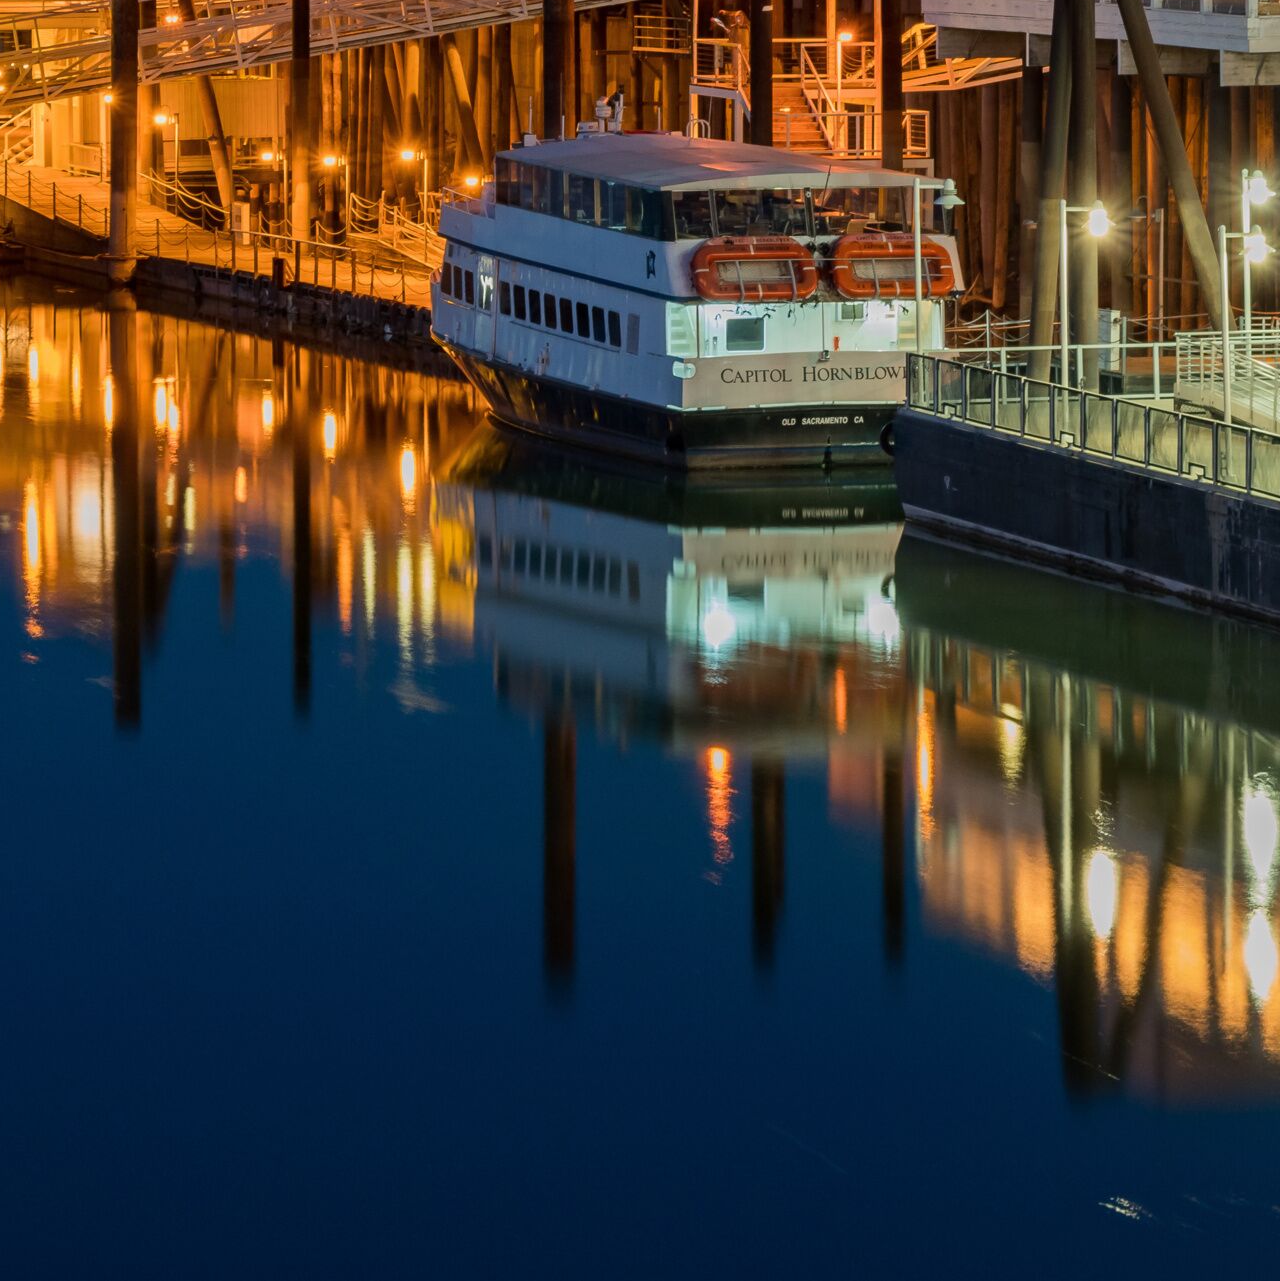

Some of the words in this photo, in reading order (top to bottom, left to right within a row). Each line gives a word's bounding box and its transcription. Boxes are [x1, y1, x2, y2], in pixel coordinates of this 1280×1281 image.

[721, 368, 792, 384] CAPITOL
[782, 418, 796, 427] OLD
[802, 416, 848, 425] SACRAMENTO
[854, 416, 864, 424] CA
